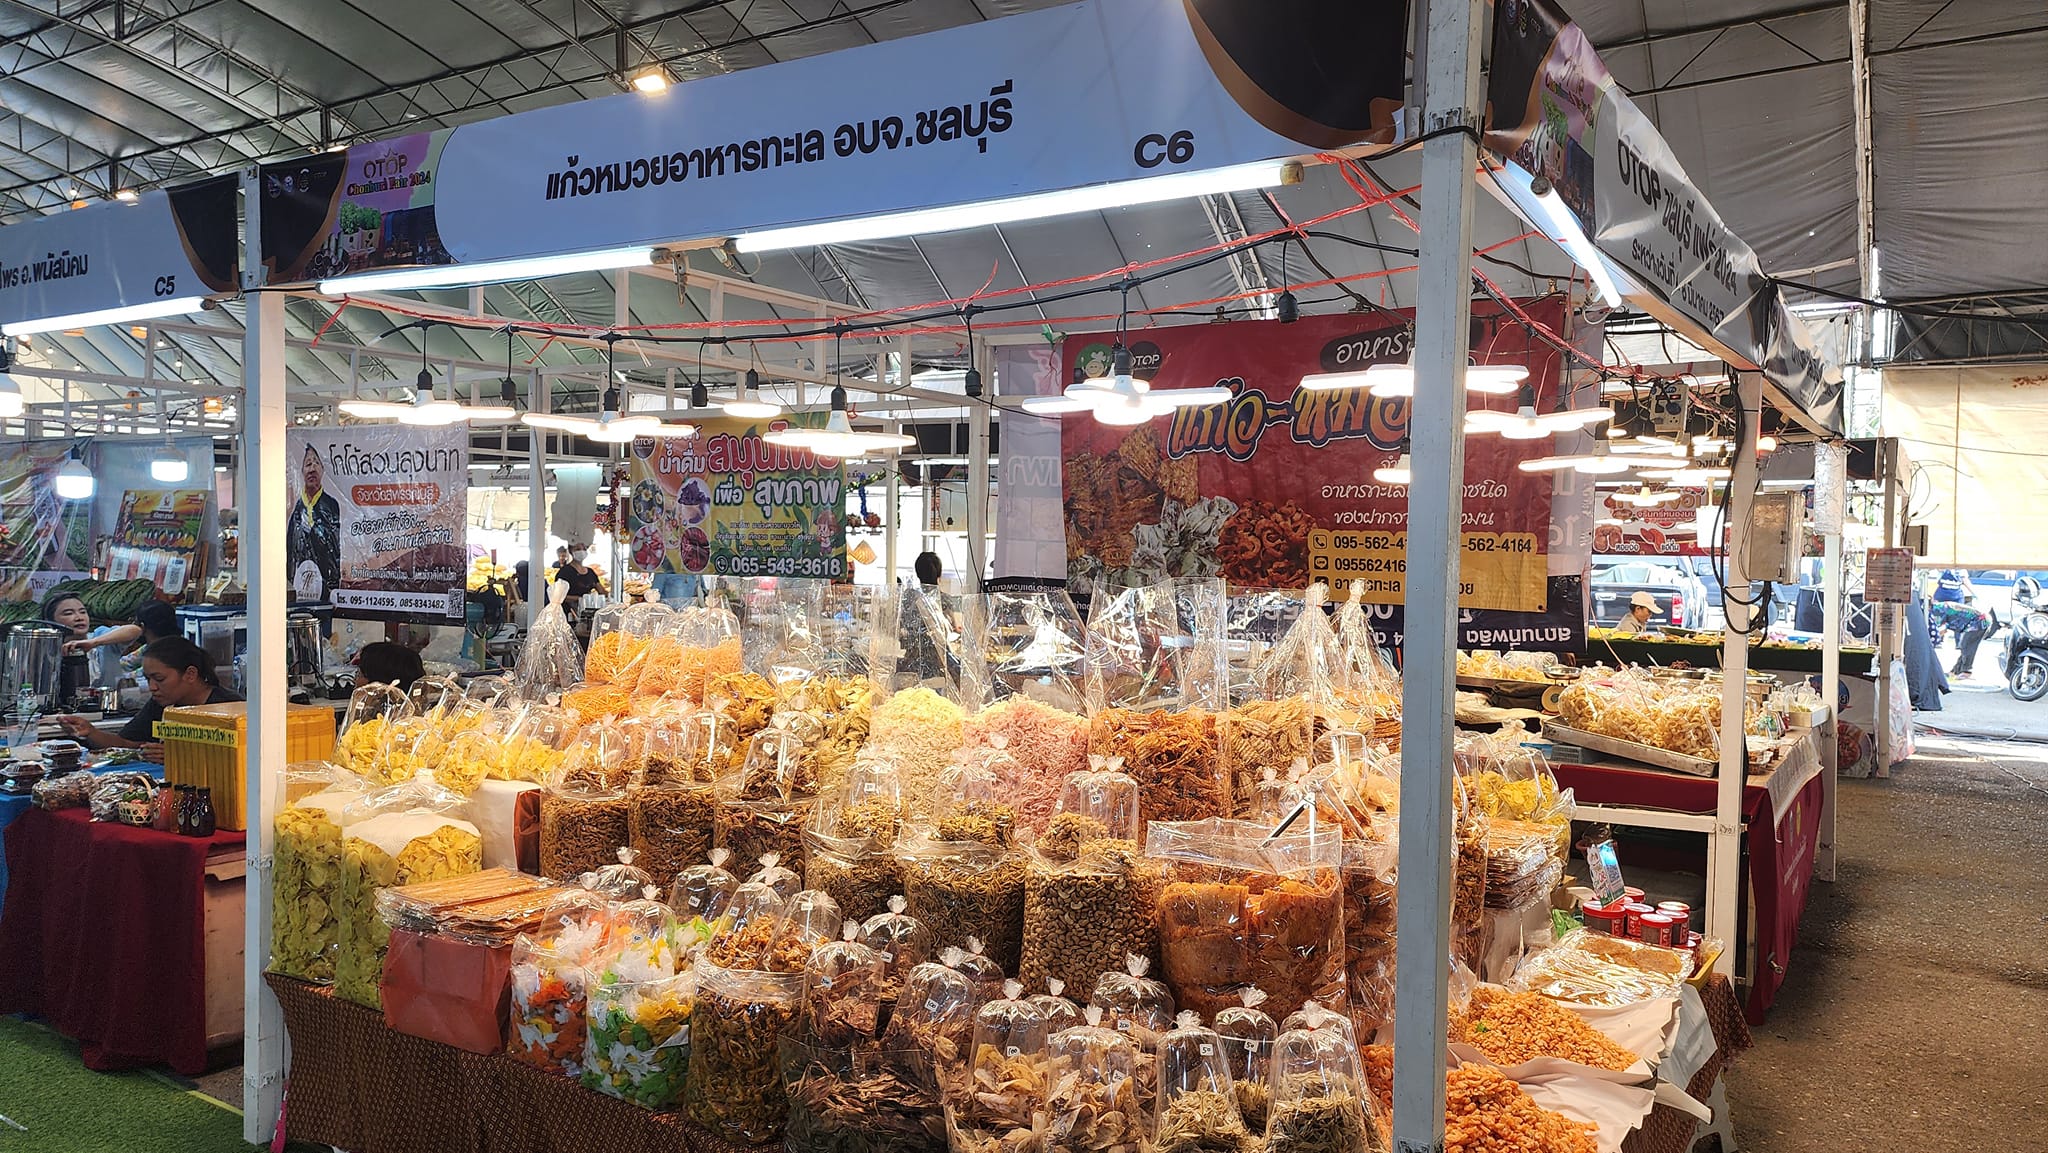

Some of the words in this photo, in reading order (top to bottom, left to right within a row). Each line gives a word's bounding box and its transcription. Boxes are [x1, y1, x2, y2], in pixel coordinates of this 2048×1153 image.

[545, 129, 825, 200] แก้วหมวยอาหารทะเล
[833, 79, 1014, 158] อบจ.ชลบุรี
[1133, 130, 1194, 169] C6
[363, 153, 408, 179] OTOP
[346, 179, 388, 197] Chonburi
[389, 174, 407, 191] Fair
[408, 170, 432, 189] 2024
[1617, 138, 1662, 211] OTOP
[1662, 187, 1696, 263] ชลบุรี
[1713, 249, 1738, 296] 2024
[154, 275, 176, 297] C5
[659, 442, 707, 474] น้ำดื่ม
[714, 474, 745, 506] เพื่อ
[754, 478, 841, 519] สุขภาพ
[731, 556, 842, 576] 065-543-3618
[399, 598, 446, 609] 085-8343482
[1466, 627, 1572, 650] สถานที่ผลิต
